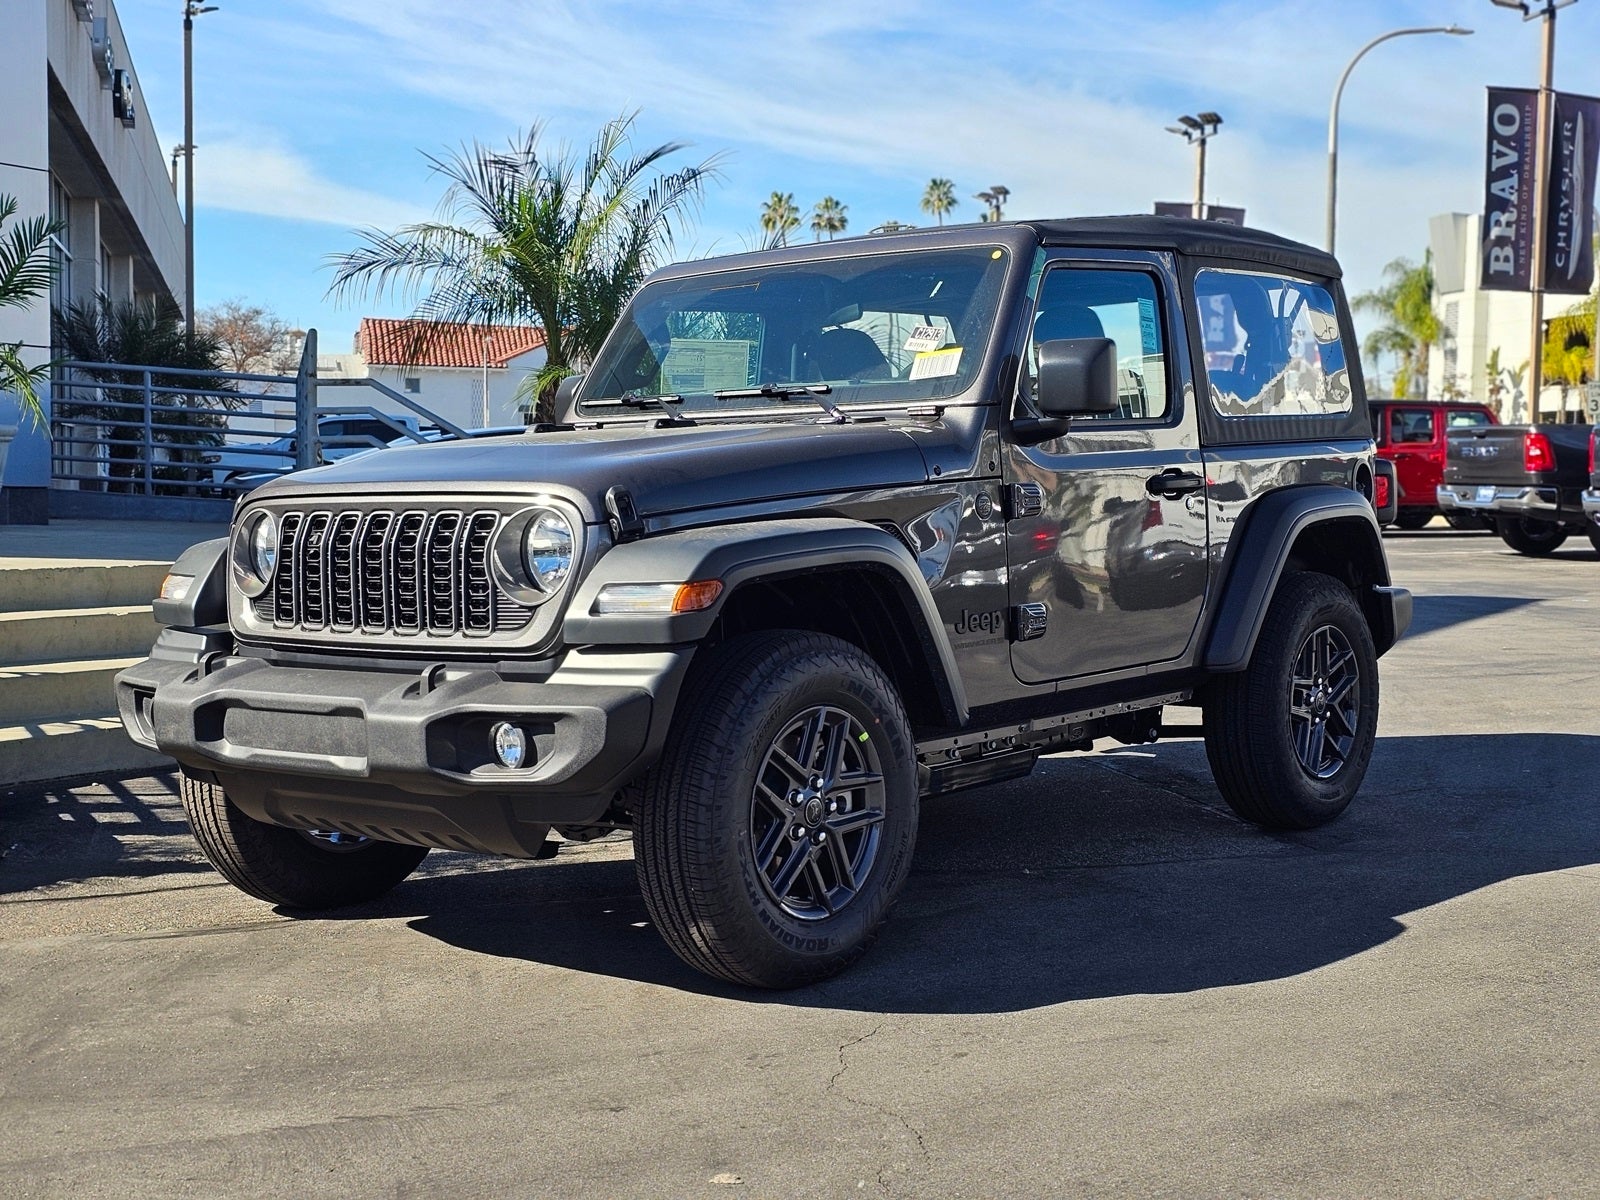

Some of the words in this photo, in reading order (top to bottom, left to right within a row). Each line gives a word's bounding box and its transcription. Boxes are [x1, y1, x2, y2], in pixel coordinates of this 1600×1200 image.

[1523, 105, 1532, 178] DEALERSHIP
[1489, 103, 1520, 276] BRAVO
[1519, 205, 1528, 233] KIND
[1522, 185, 1529, 199] OF
[1556, 122, 1573, 267] CHRYSLER
[955, 608, 1003, 635] Jeep
[846, 673, 906, 761] NEXEN
[757, 907, 830, 952] ROADIAN
